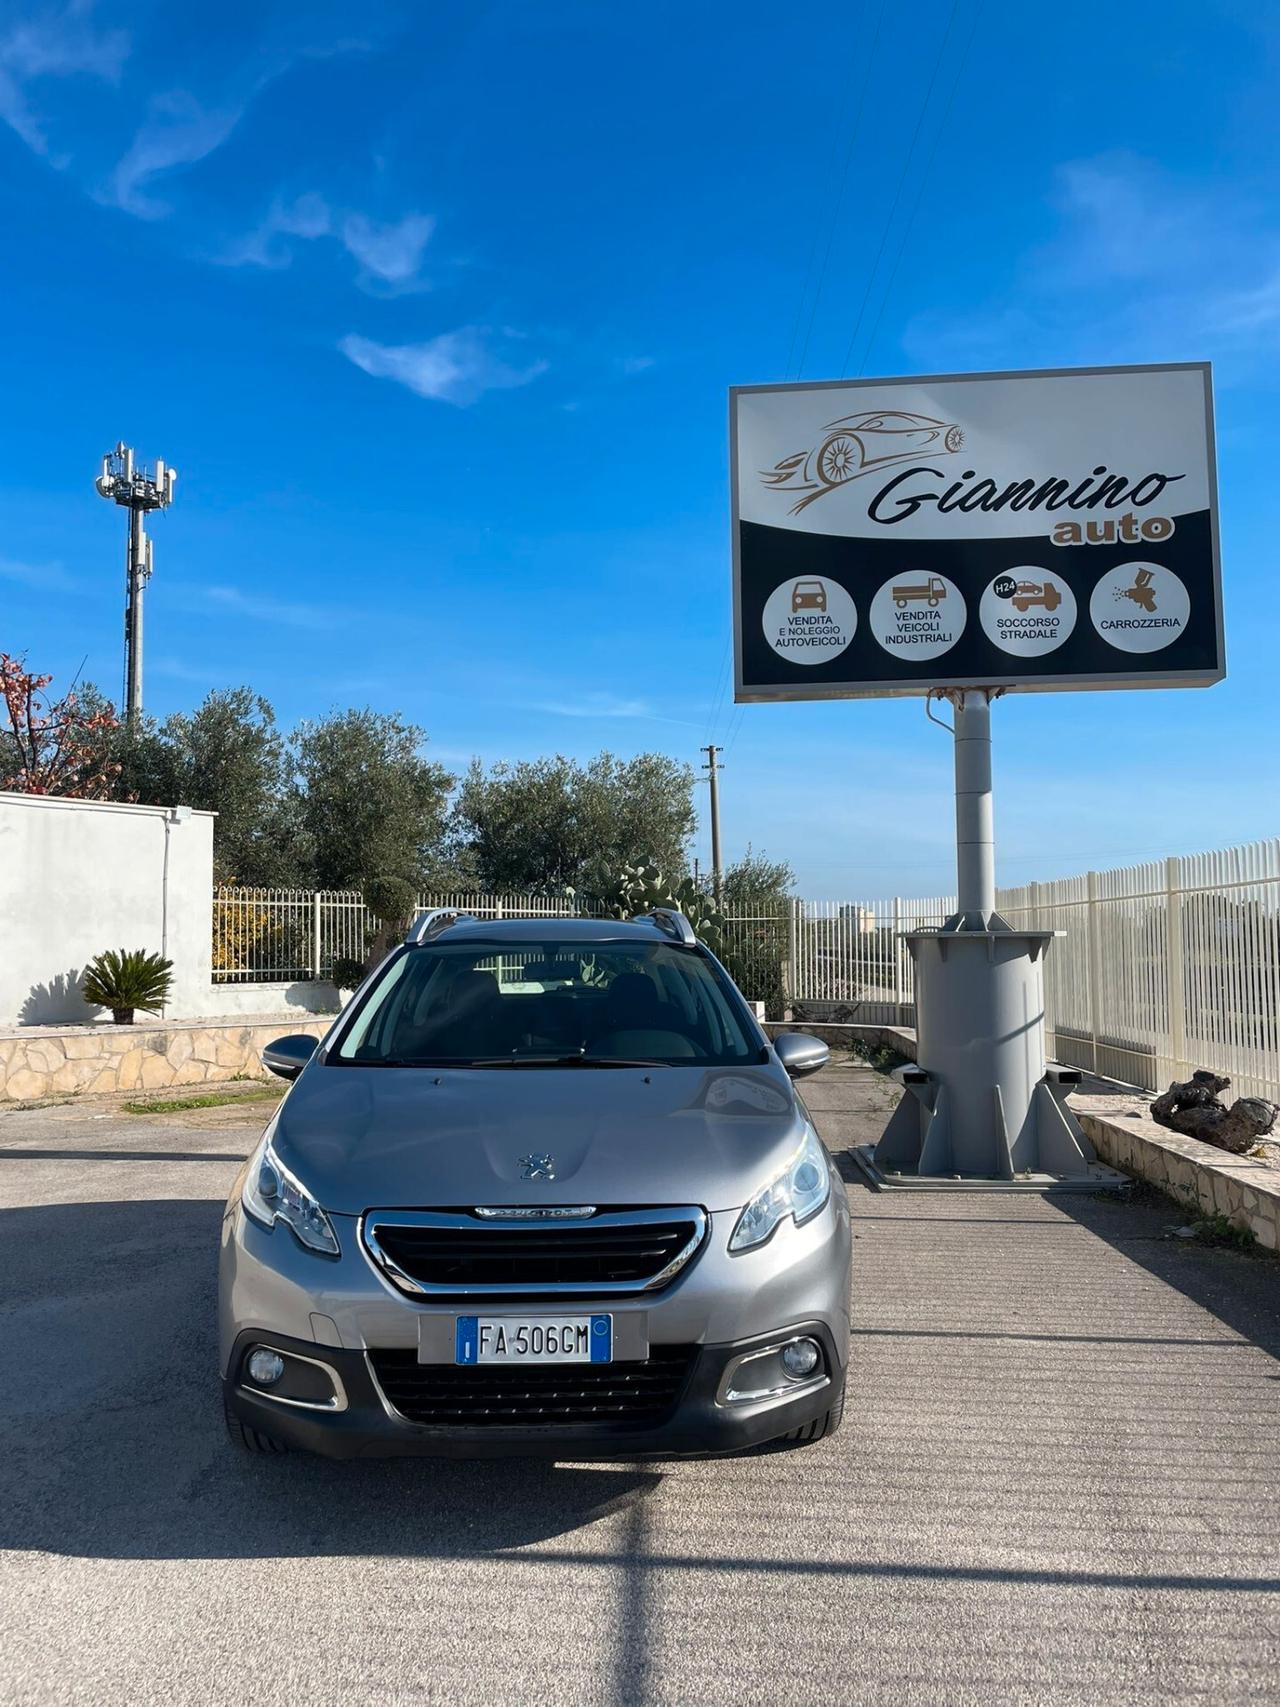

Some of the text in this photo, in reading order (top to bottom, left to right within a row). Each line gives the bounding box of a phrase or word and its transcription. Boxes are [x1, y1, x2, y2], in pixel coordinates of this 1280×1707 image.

[867, 466, 1186, 525] Giannino
[1052, 511, 1174, 545] auto
[995, 581, 1016, 594] H24
[787, 615, 833, 626] VENDITA
[894, 610, 941, 621] VENDITA
[896, 622, 940, 633] VEICOLI
[996, 617, 1060, 629] SOCCORSO
[1100, 618, 1181, 630] CARROZZERIA
[779, 625, 841, 636] E NOLEGGIO
[1000, 629, 1058, 640] STRADALE
[775, 636, 846, 648] AUTOVEICOLI
[885, 632, 952, 645] INDUSTRIALI
